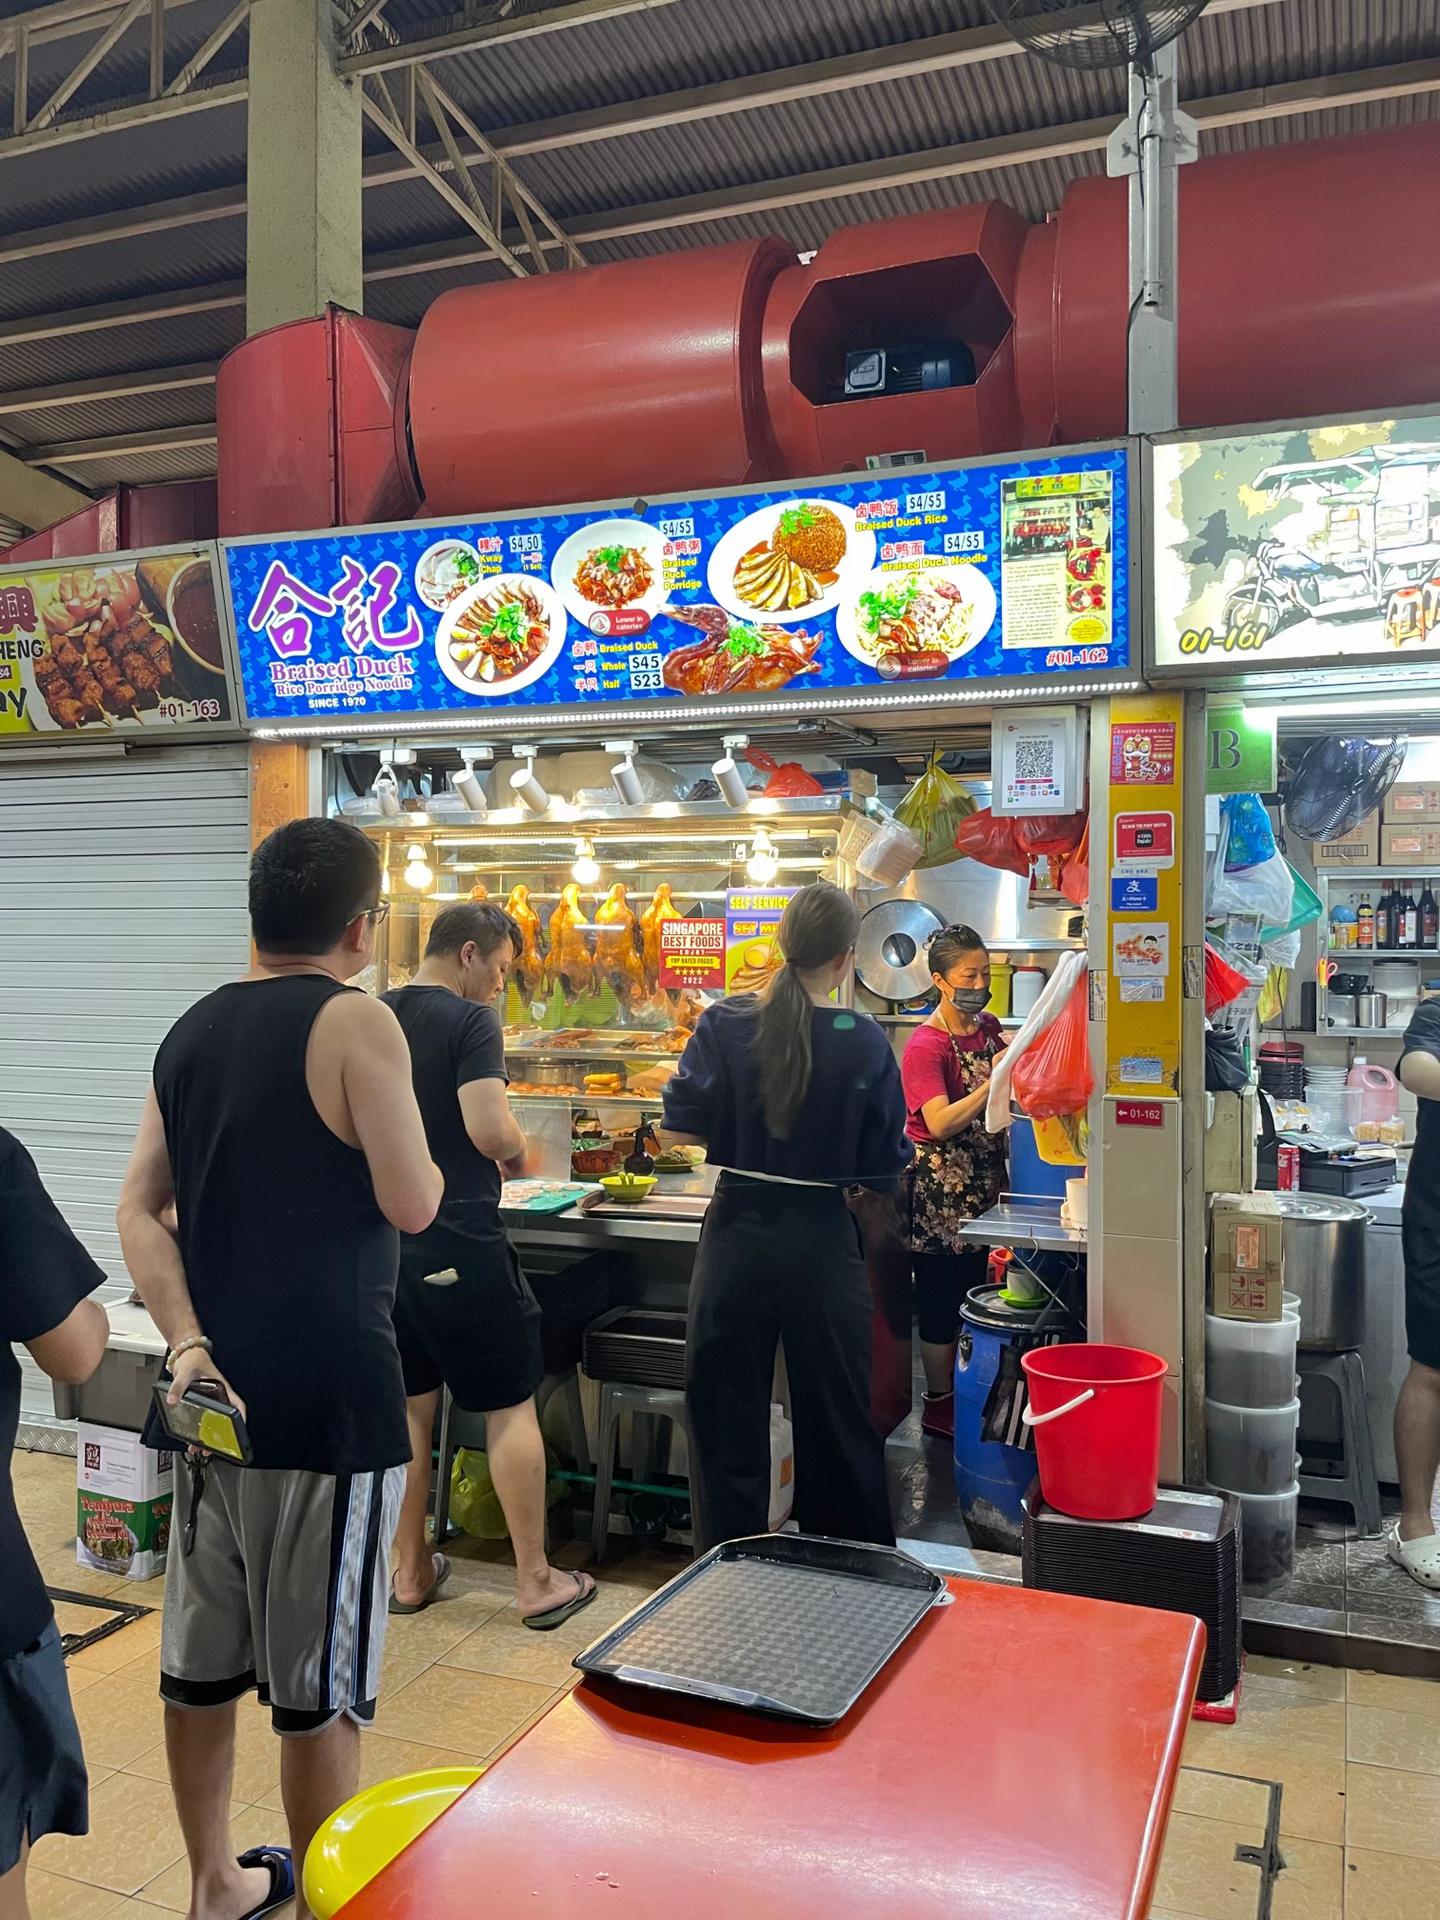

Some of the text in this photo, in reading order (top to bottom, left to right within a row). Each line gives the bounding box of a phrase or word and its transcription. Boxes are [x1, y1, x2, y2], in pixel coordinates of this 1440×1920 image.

[855, 499, 898, 518] 卤鸭饭
[910, 493, 942, 510] $4/$5
[662, 520, 691, 536] $4/$5
[855, 514, 948, 532] Braised Duck Rice
[511, 535, 539, 551] $4.50
[947, 533, 980, 550] $4/$5
[881, 540, 925, 560] 卤鸭面
[480, 554, 503, 563] Kway
[662, 557, 697, 569] Braised
[882, 553, 988, 572] Braised Duck Noodle
[481, 565, 502, 574] Chap
[663, 569, 686, 579] Duck
[664, 579, 702, 591] Porridge
[249, 558, 422, 657] 合記
[1180, 624, 1268, 654] 01-161
[600, 641, 658, 654] Braised Duck
[632, 655, 659, 669] $45
[907, 657, 930, 665] Lower
[1047, 648, 1108, 666] #01-162
[270, 653, 412, 681] Braised Duck
[601, 662, 627, 671] Whole
[907, 664, 938, 673] calories
[276, 676, 411, 697] Rice Porridge Noodle
[603, 679, 620, 689] Half
[634, 674, 661, 687] $23
[308, 696, 367, 708] SINCE 1970
[159, 701, 219, 718] #01-163
[1210, 730, 1242, 769] B
[730, 895, 789, 909] SELF SERVICE
[662, 923, 724, 935] SINGAPORE
[733, 921, 758, 936] SET
[664, 936, 721, 947] BEST FOODS
[682, 976, 703, 984] 2022
[1129, 1108, 1160, 1120] 01-162
